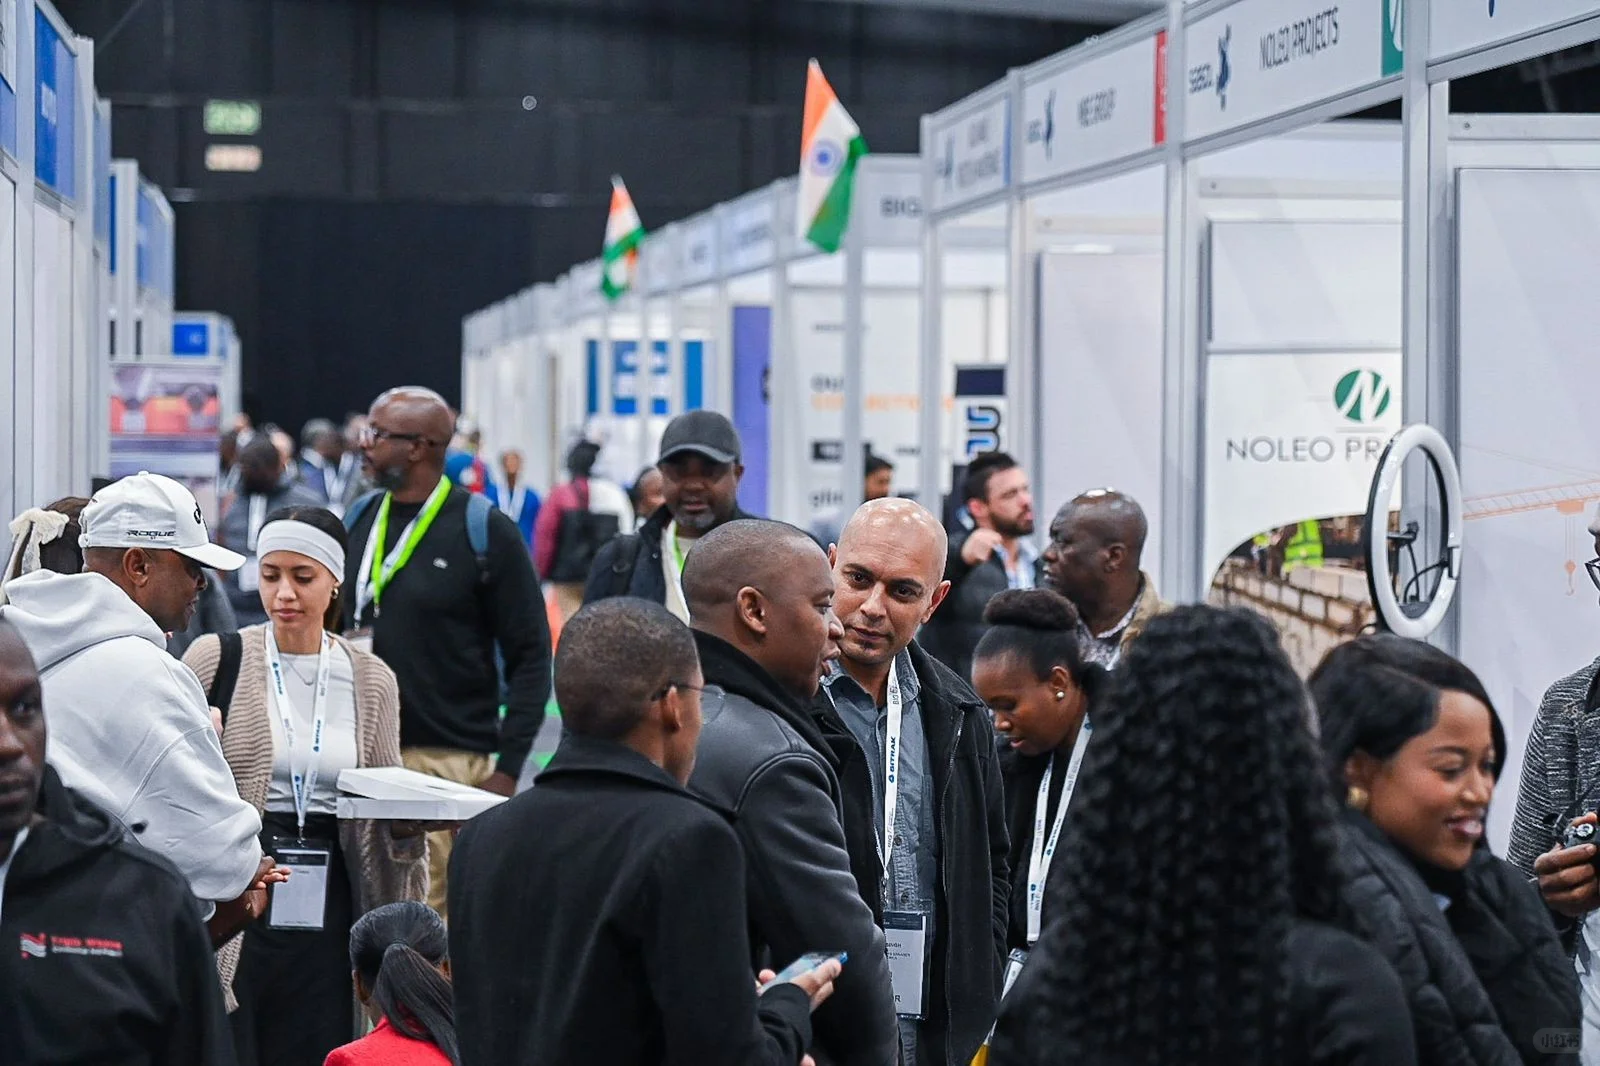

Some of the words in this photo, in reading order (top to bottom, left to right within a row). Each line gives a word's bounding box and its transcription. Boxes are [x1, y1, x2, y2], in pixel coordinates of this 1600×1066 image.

[1292, 6, 1340, 58] PROJECTS
[1226, 436, 1335, 463] NOLEO
[1345, 437, 1382, 463] PR
[126, 529, 176, 537] ROGUE
